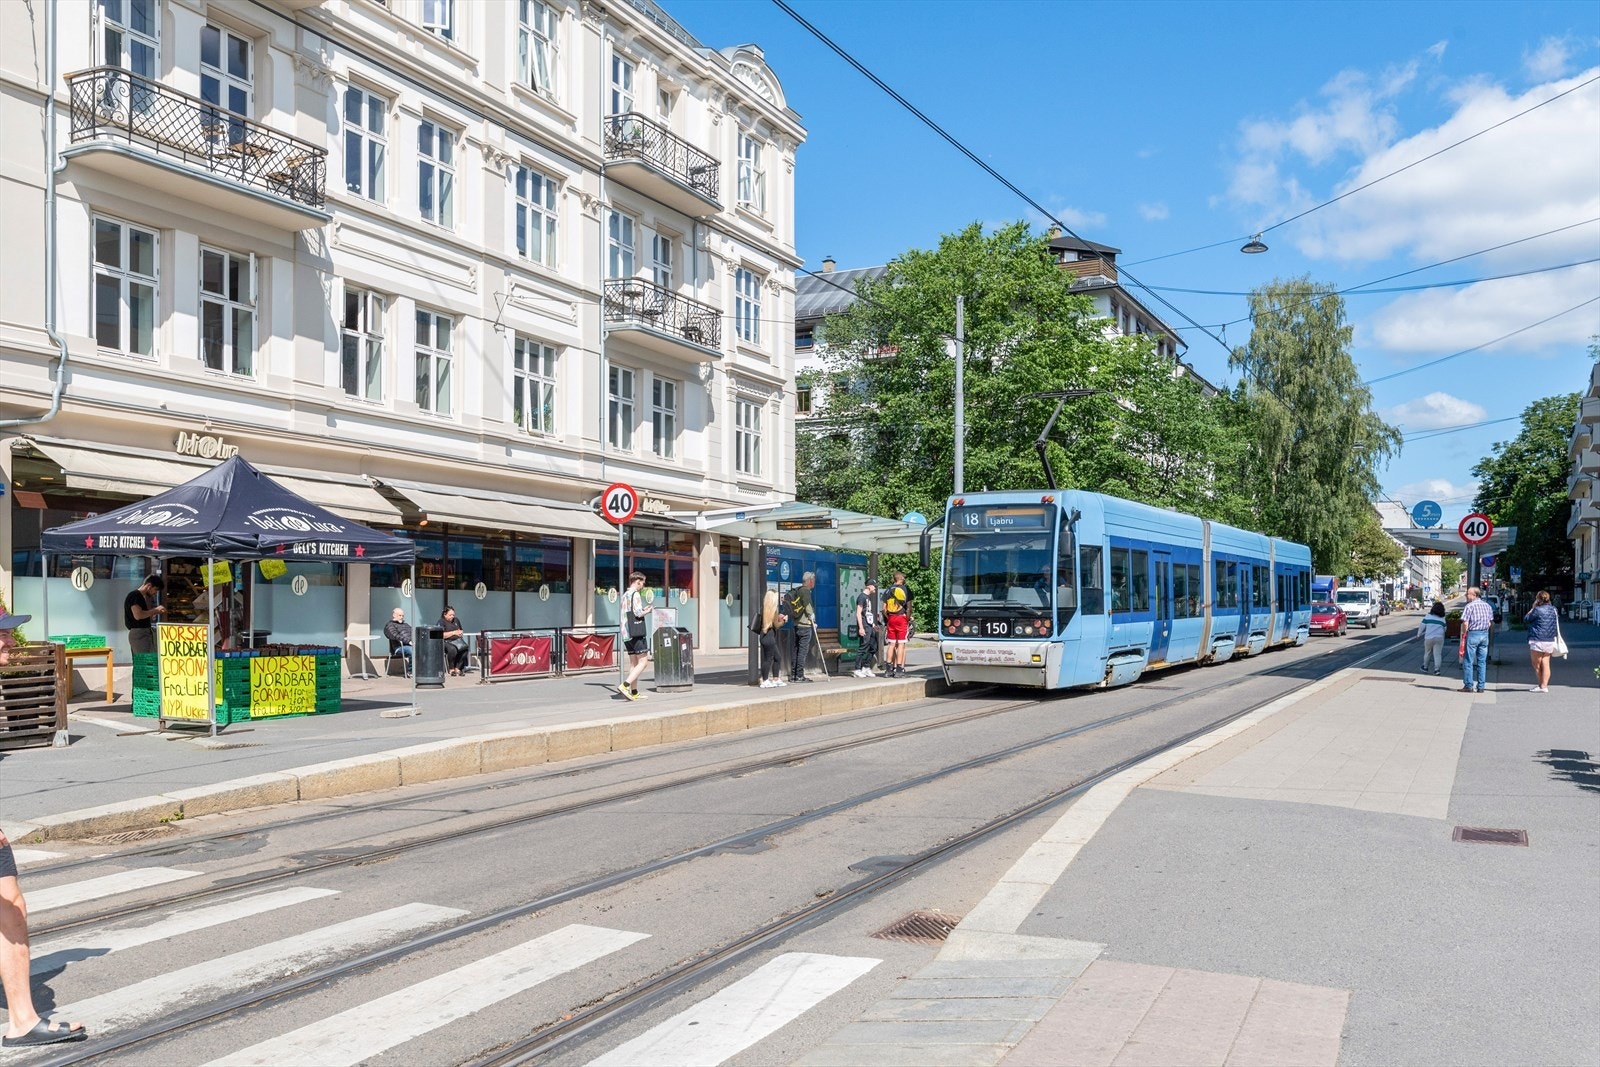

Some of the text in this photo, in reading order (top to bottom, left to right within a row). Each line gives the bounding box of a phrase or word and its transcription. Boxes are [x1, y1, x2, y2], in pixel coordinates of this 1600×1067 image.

[177, 431, 199, 455] Deli
[609, 493, 632, 513] 40
[1421, 504, 1433, 517] 5
[248, 515, 287, 530] Deli
[302, 517, 343, 533] Luca
[964, 512, 979, 526] 18
[990, 517, 1014, 527] Ljabru
[1464, 521, 1487, 537] 40
[99, 536, 146, 549] DELI'S KITCHEN
[293, 542, 349, 556] DELI'S KITCHEN
[75, 567, 89, 589] de
[294, 575, 305, 594] de
[160, 625, 208, 642] NORSKE
[985, 622, 1008, 635] 150
[162, 658, 208, 677] CORONA
[253, 655, 315, 674] NORSKE
[253, 687, 290, 703] CORONA
